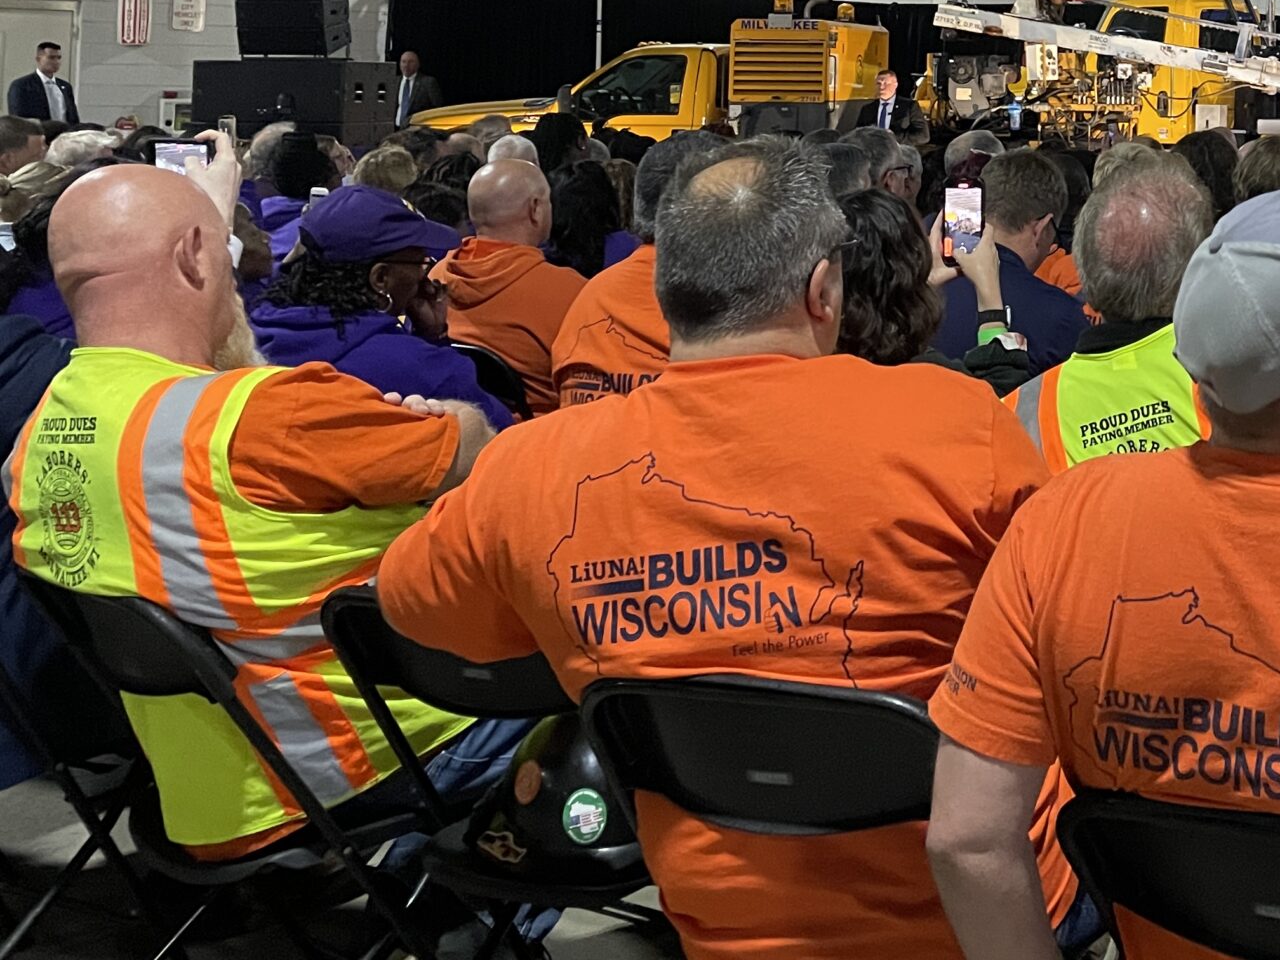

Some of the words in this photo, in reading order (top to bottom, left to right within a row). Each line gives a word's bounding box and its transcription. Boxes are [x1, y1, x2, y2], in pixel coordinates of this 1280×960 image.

[69, 417, 97, 431] DUES
[1080, 413, 1128, 437] PROUD
[1131, 401, 1171, 423] DUES
[1082, 428, 1124, 449] PAYING
[1125, 415, 1174, 435] MEMBER
[61, 433, 95, 444] MEMBER
[648, 539, 788, 590] BUILDS
[571, 581, 802, 646] WISCONSIN
[732, 639, 759, 657] Feel
[762, 639, 784, 652] the
[788, 631, 830, 649] Power
